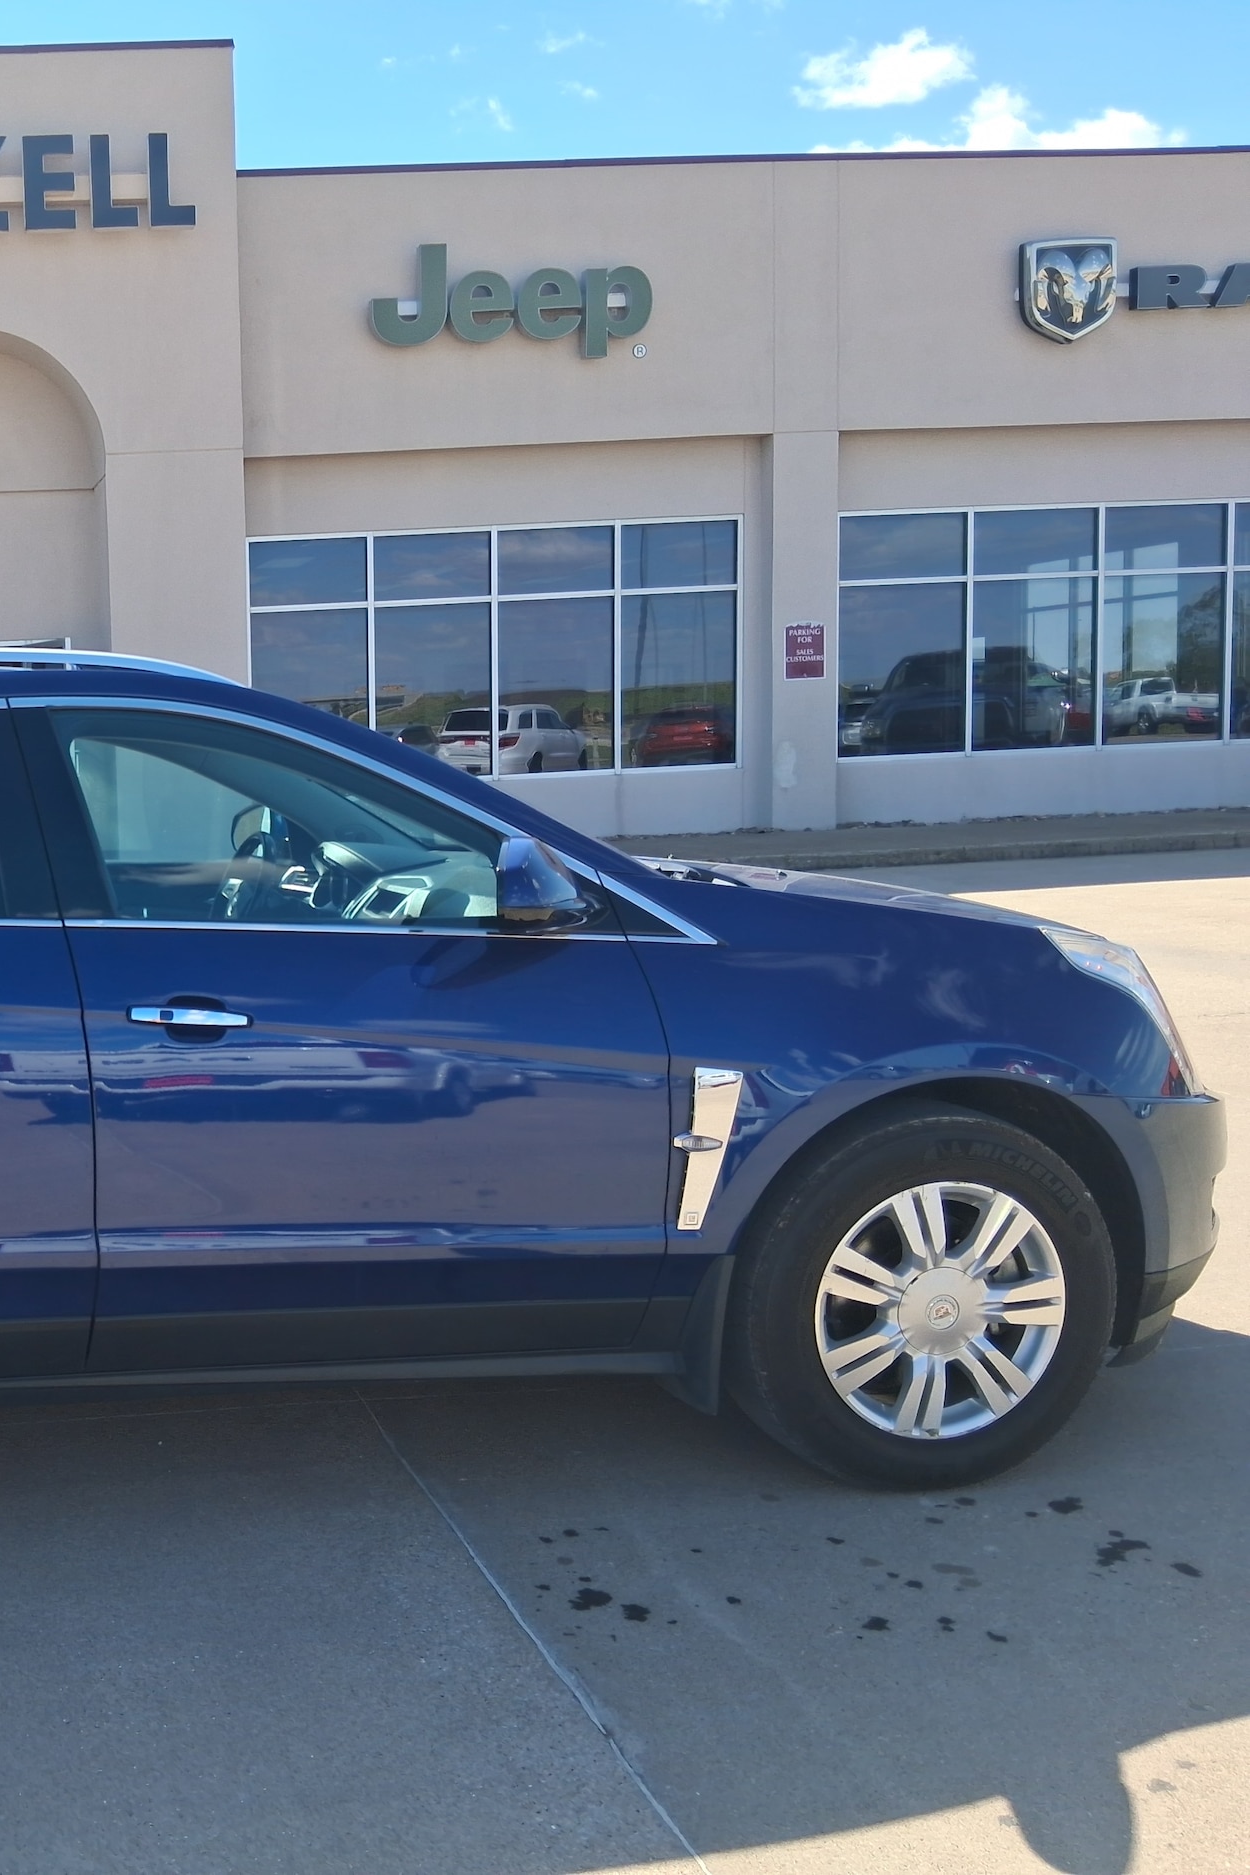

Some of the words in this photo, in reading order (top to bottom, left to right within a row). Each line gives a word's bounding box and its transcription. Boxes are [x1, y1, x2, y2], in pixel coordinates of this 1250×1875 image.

[368, 243, 653, 360] Jeep
[789, 628, 820, 636] PARKING
[969, 1141, 1078, 1207] MICHELIN
